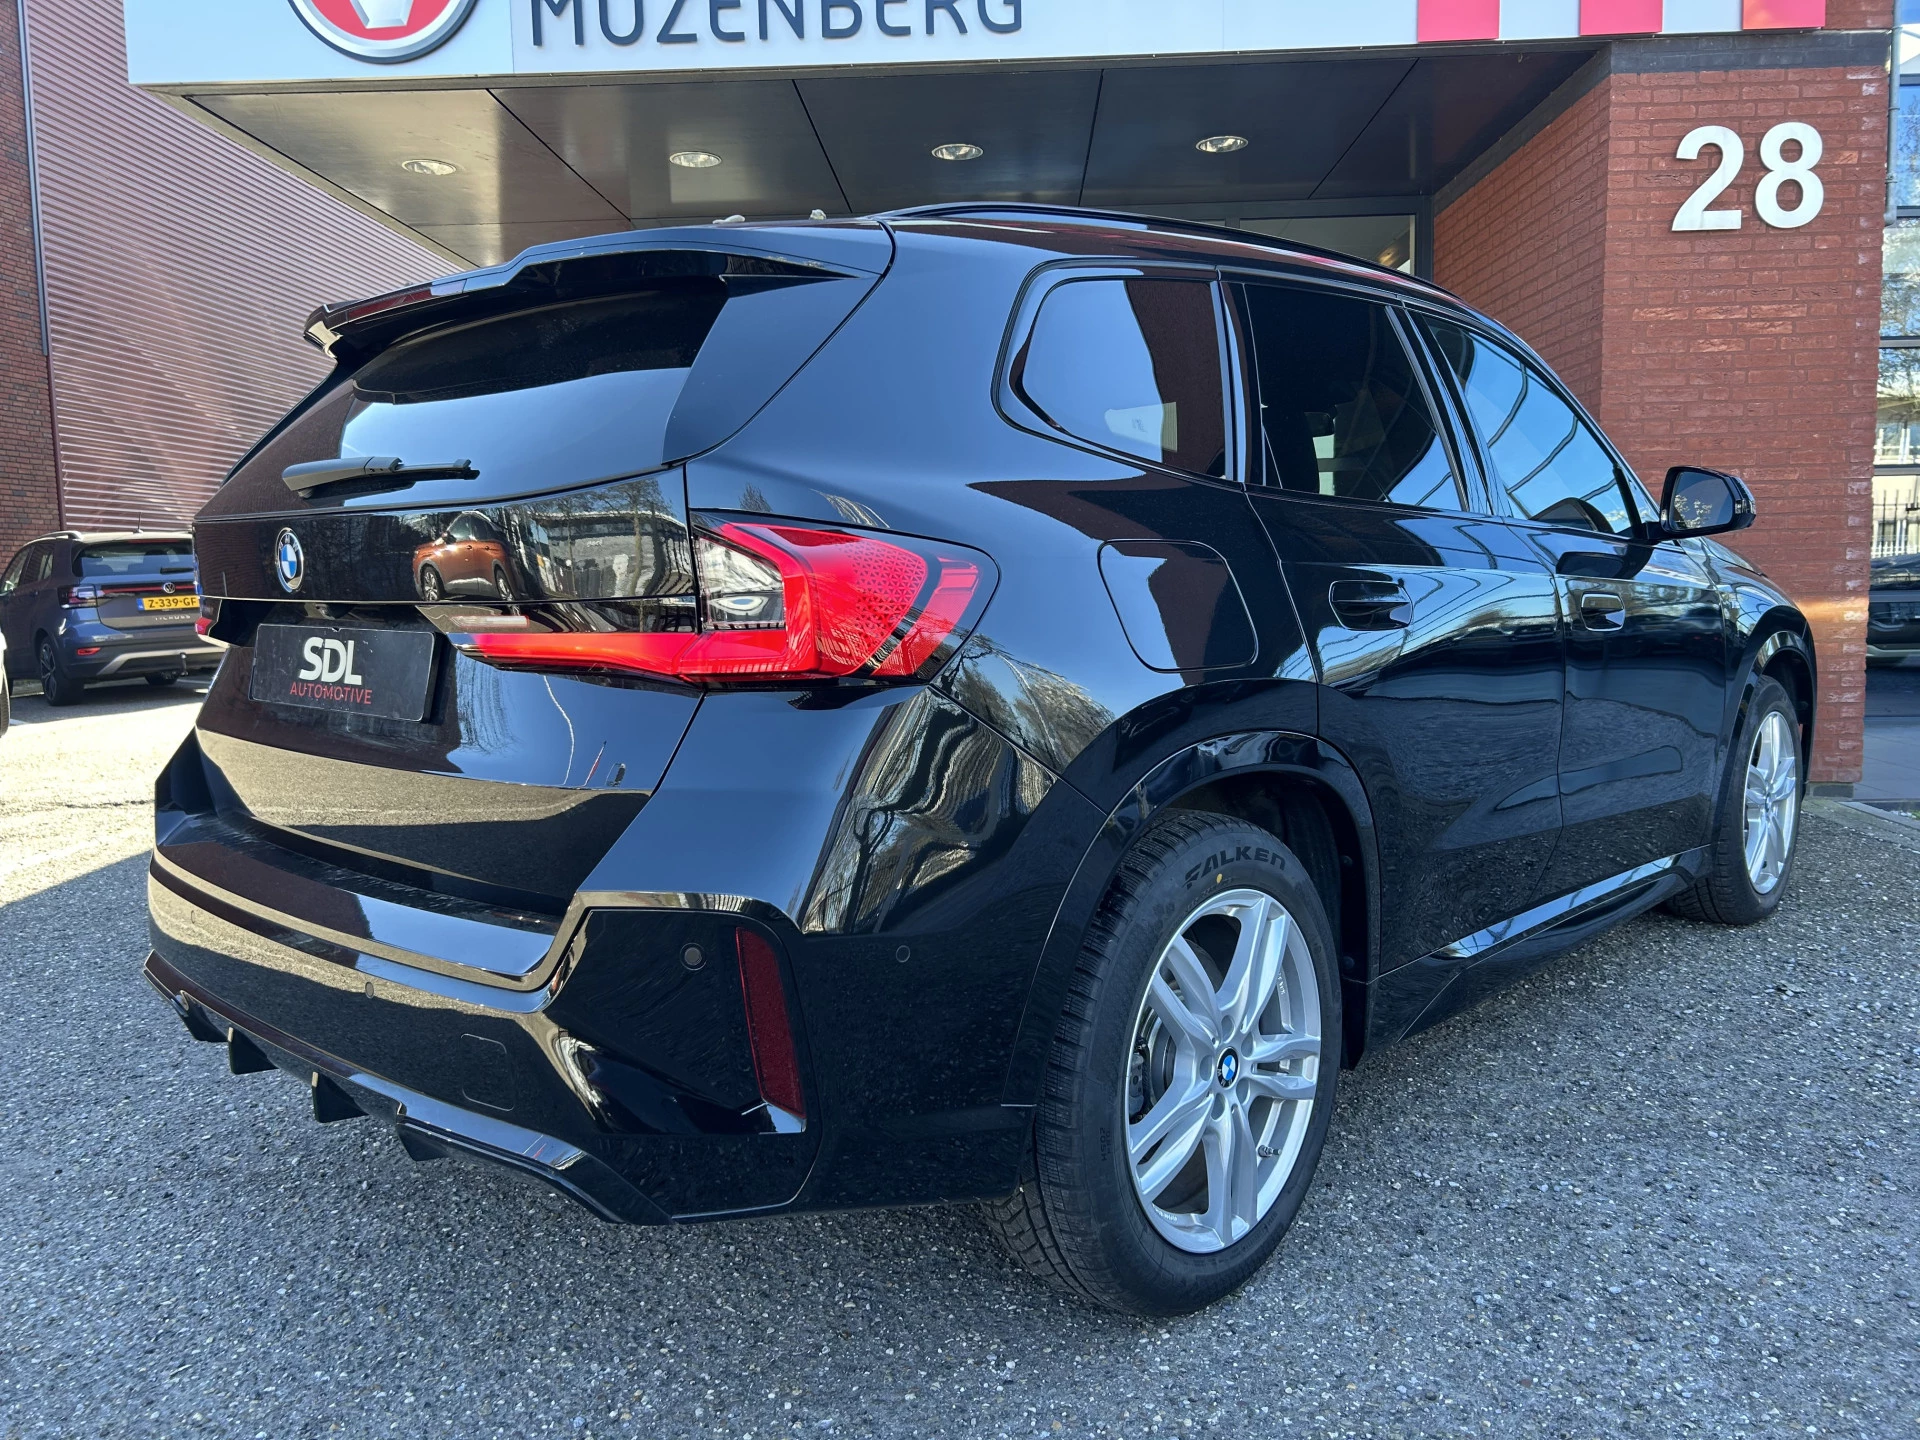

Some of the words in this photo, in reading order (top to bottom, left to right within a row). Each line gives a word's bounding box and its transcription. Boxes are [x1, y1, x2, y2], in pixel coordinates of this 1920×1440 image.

[1671, 121, 1825, 232] 28
[148, 597, 197, 608] Z-339-GF
[299, 636, 363, 686] SDL
[289, 681, 373, 705] AUTOMOTIVE
[1182, 846, 1287, 890] FALKEN
